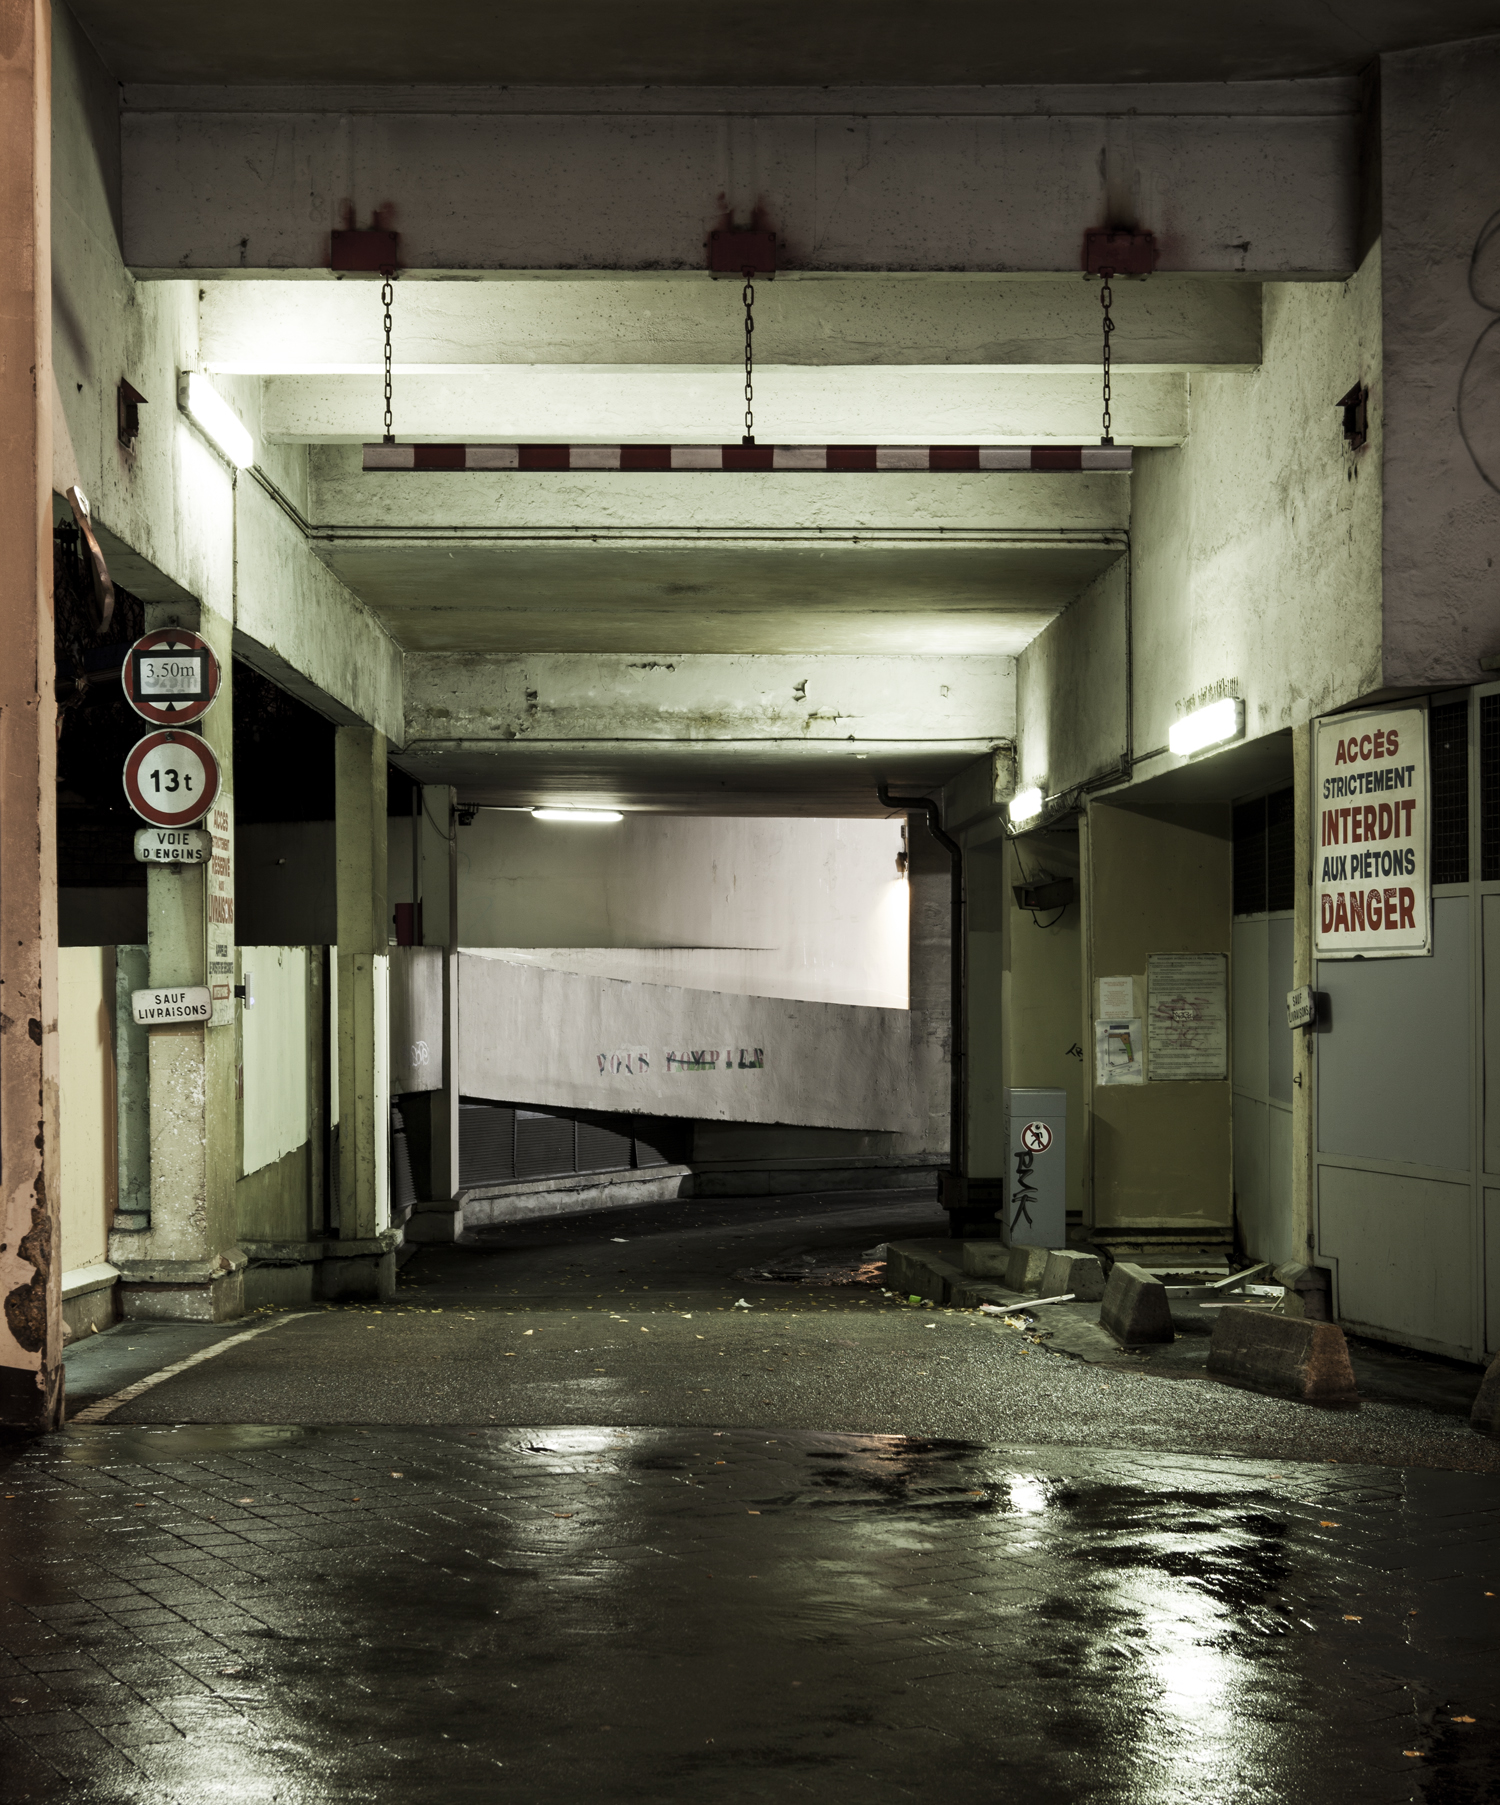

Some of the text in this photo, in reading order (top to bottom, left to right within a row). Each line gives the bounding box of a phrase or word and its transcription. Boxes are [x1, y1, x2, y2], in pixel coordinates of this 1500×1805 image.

[146, 662, 195, 678] 3.50m
[1335, 729, 1399, 766] ACCÈS
[1323, 765, 1415, 799] STRICTEMENT
[1321, 798, 1416, 847] INTERDIT
[157, 833, 190, 845] VOIE
[143, 848, 203, 860] D'ENGINS
[1321, 847, 1416, 883] AUX PIÉTONS
[1321, 887, 1416, 934] DANGER
[154, 992, 186, 1005] SAUF
[596, 1052, 650, 1076] VOIE
